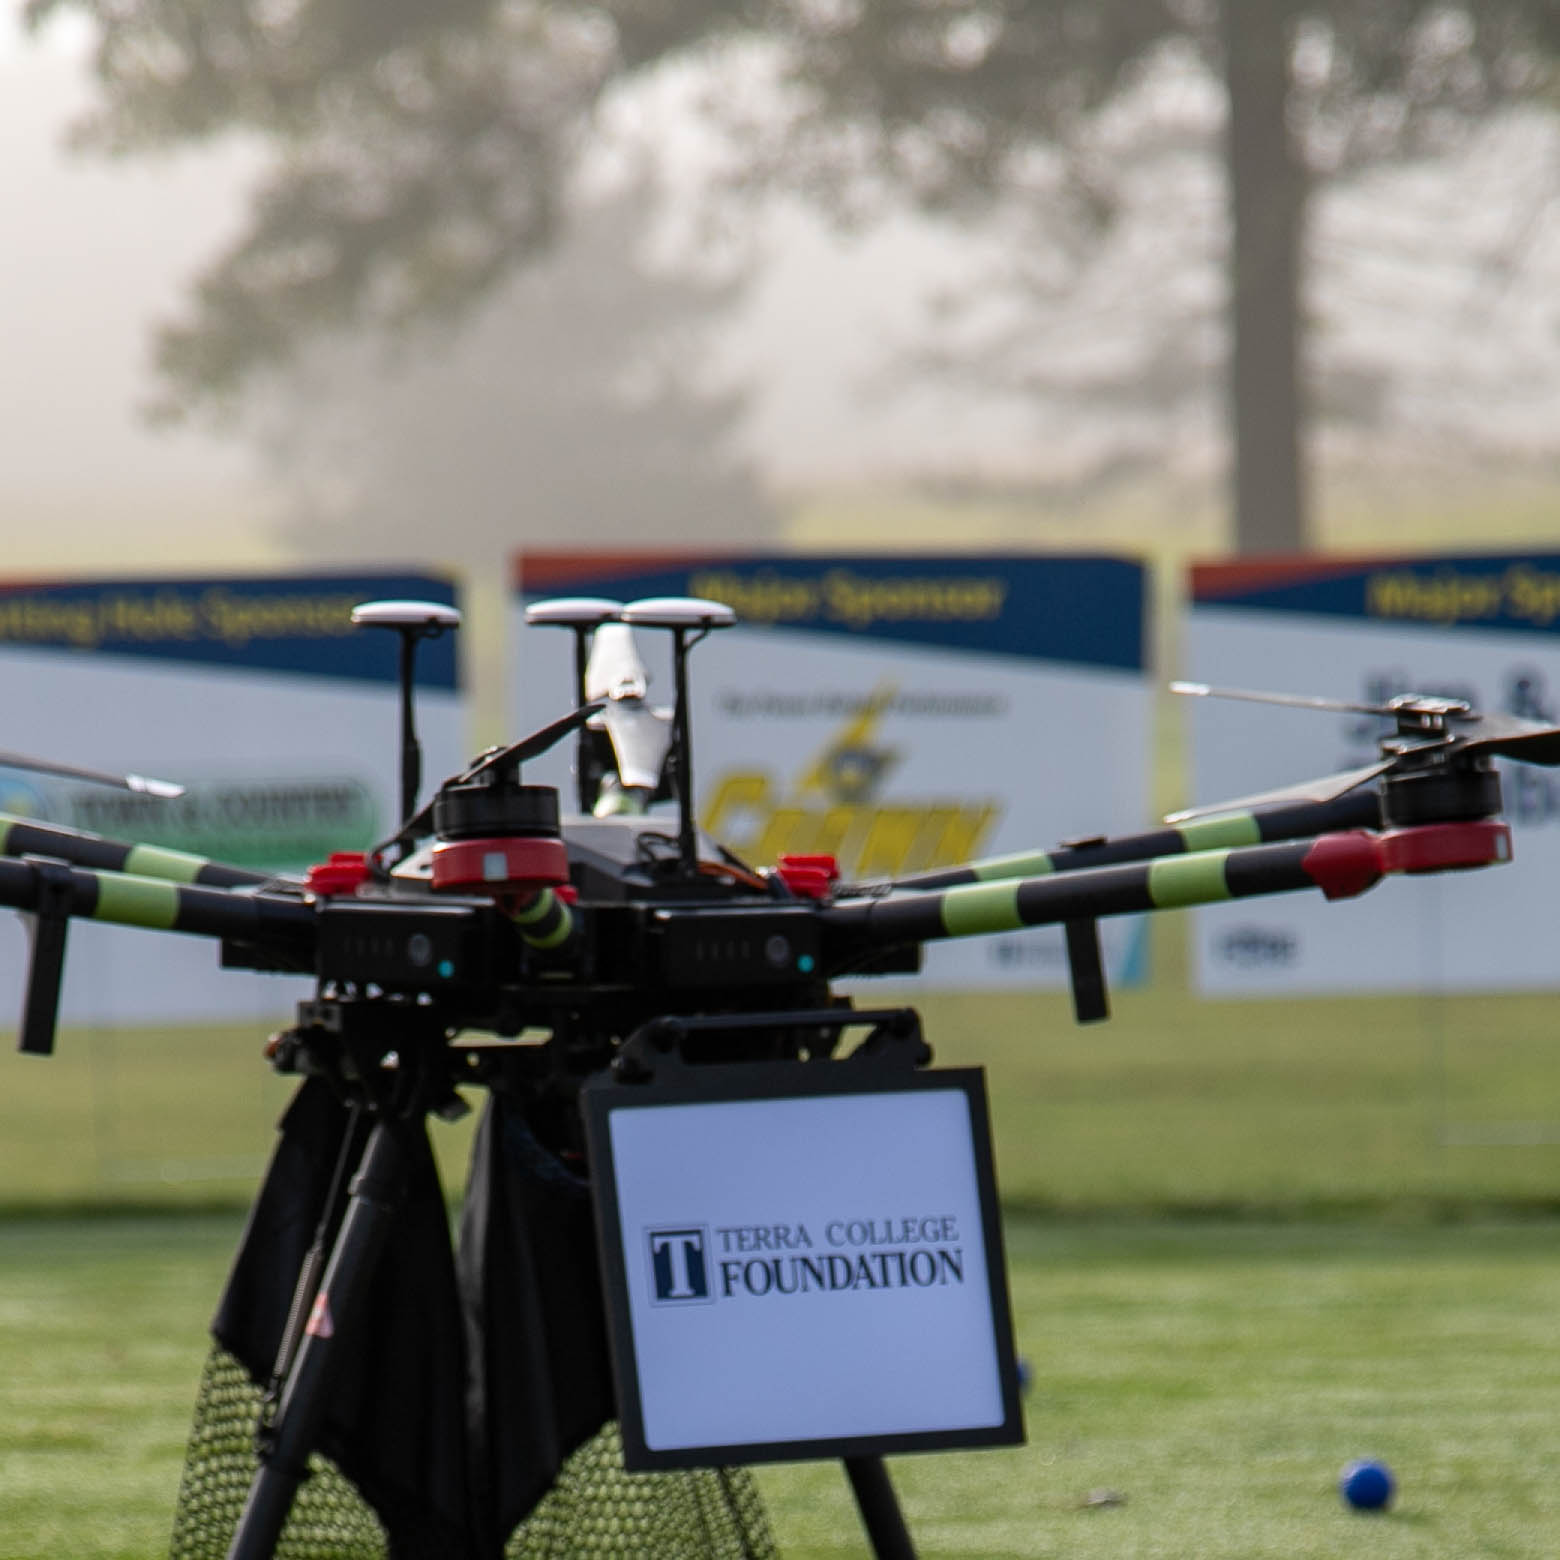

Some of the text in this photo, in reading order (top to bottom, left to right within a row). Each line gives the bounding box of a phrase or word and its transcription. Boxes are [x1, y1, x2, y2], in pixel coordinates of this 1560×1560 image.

[716, 1216, 961, 1253] TERRA COLLEGE
[719, 1248, 965, 1298] FOUNDATION
